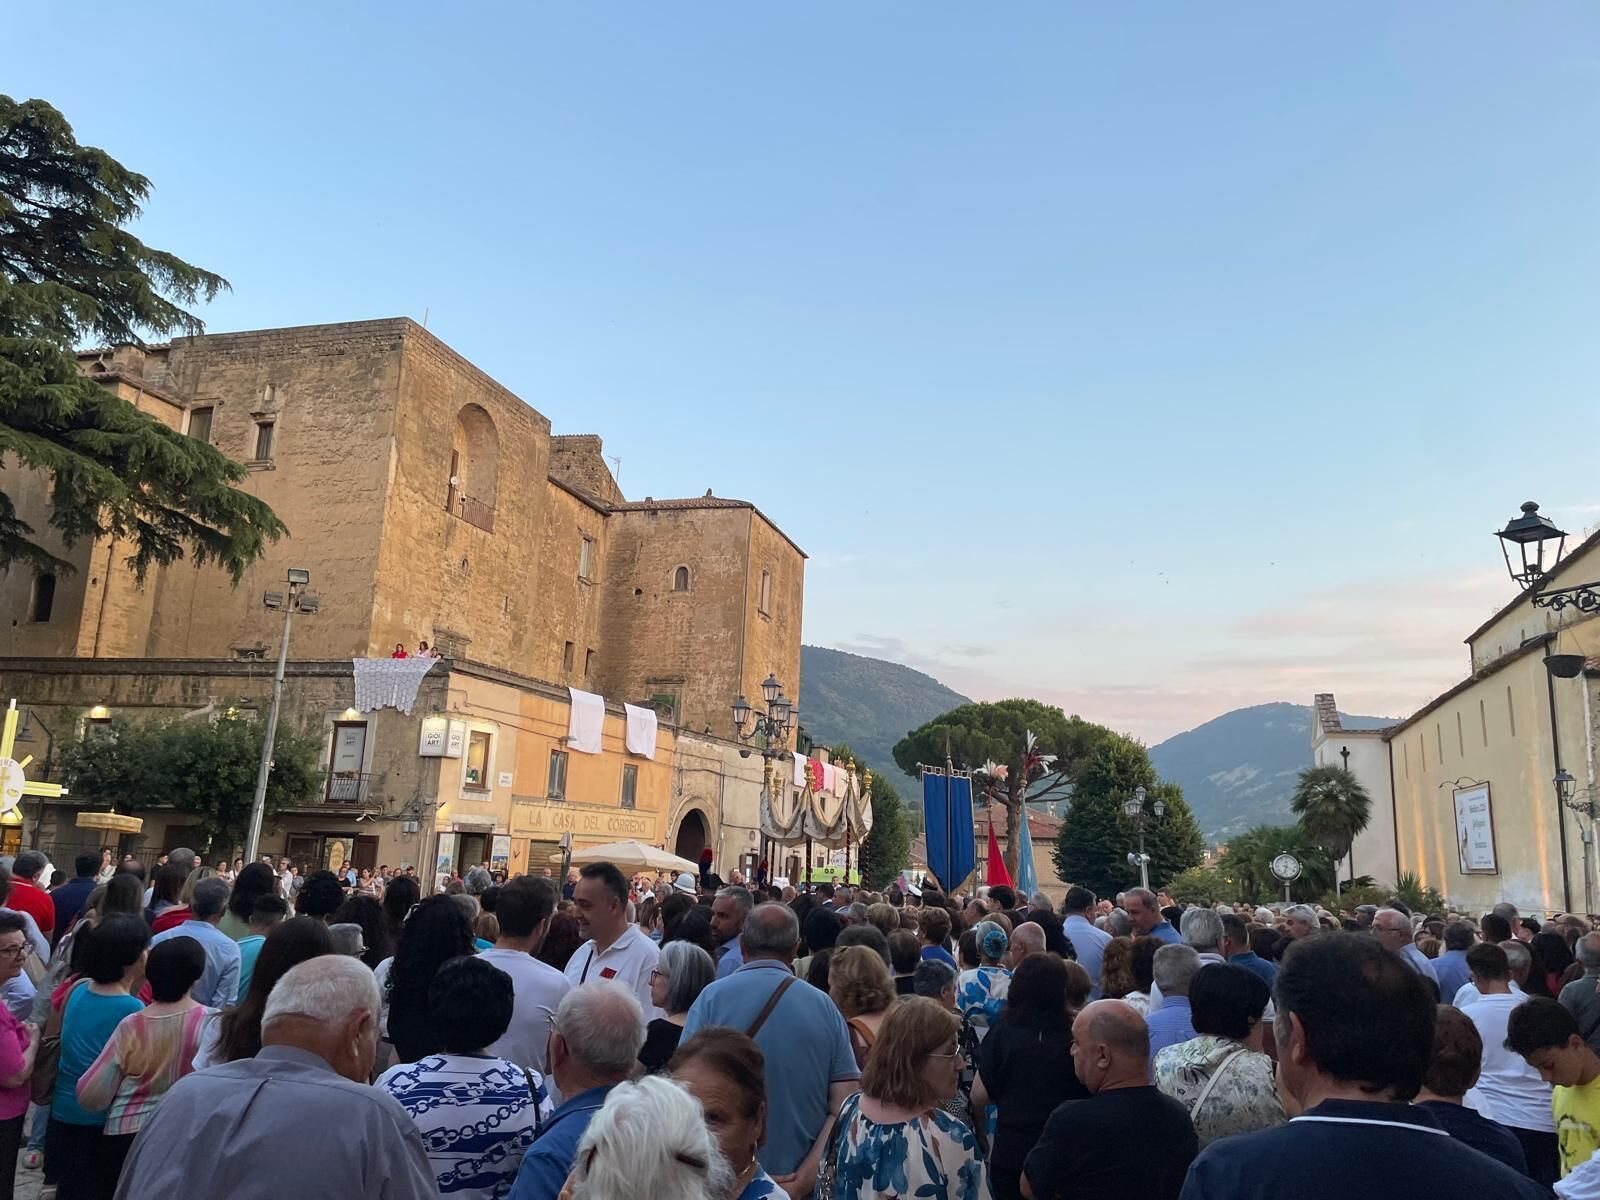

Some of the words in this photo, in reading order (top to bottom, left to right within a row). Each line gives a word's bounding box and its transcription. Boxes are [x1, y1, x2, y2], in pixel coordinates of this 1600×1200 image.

[528, 810, 542, 826] LA
[552, 812, 576, 830] CASA
[583, 815, 600, 831] DEL
[607, 817, 646, 834] CORREDO
